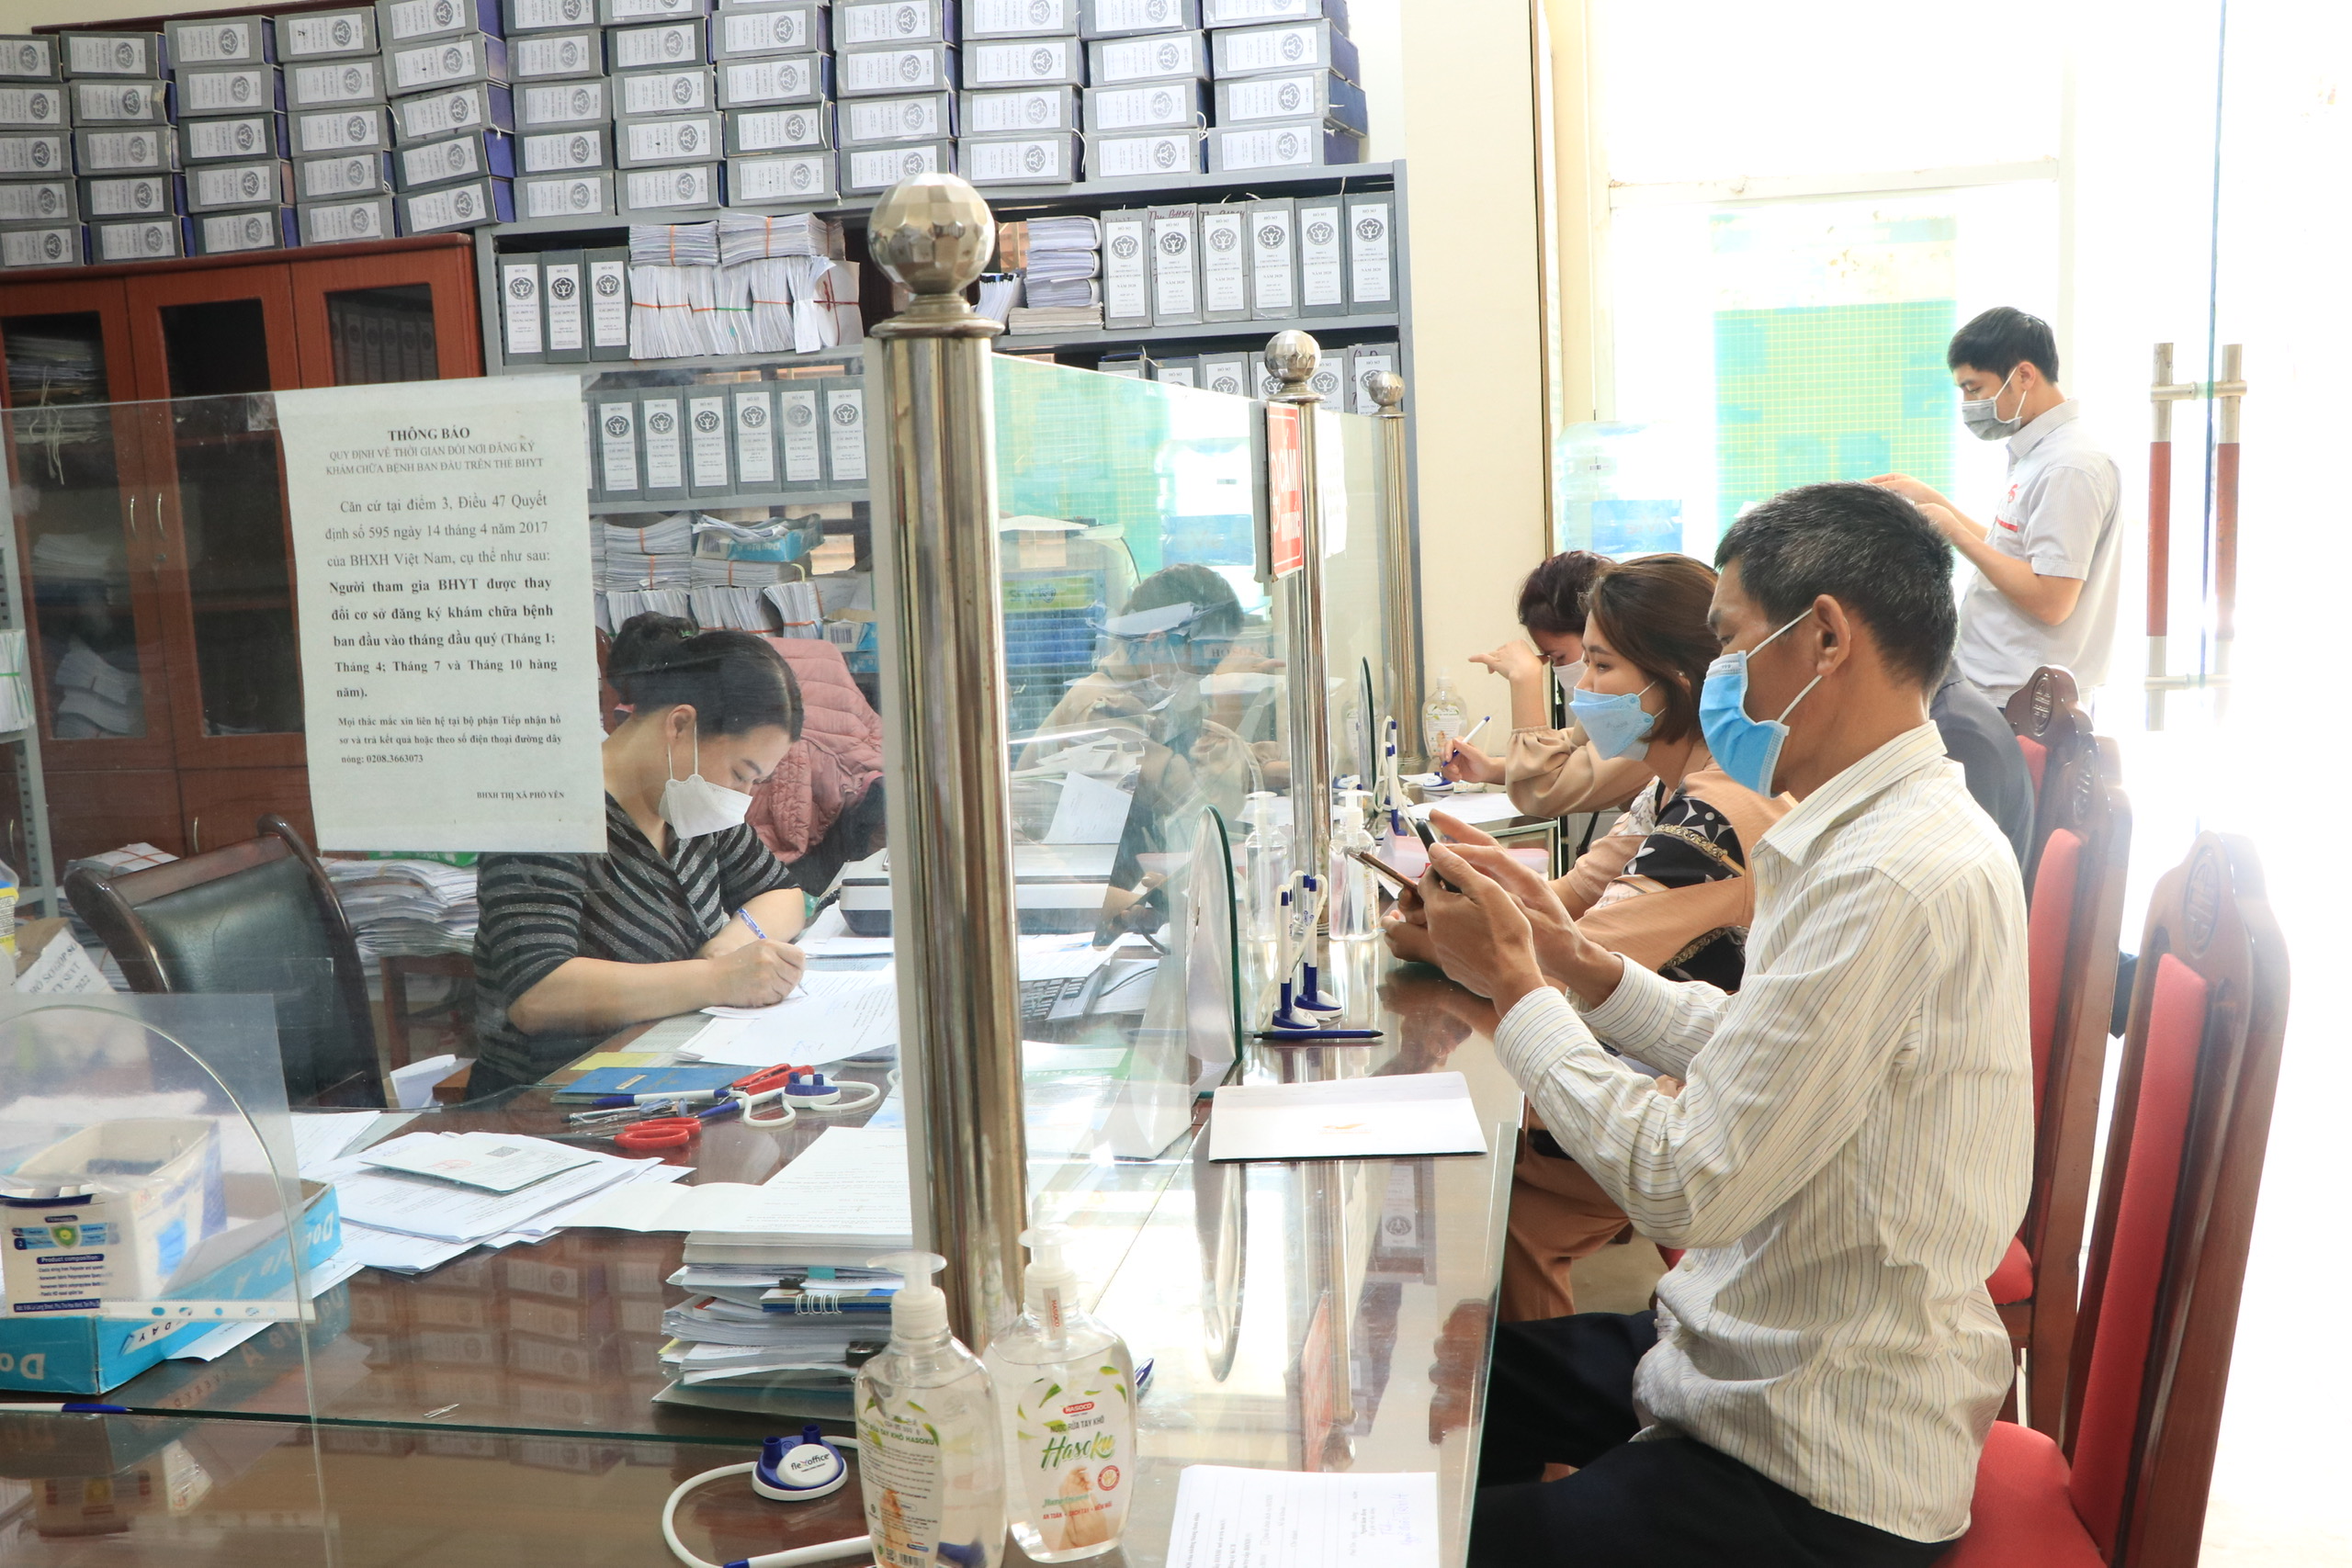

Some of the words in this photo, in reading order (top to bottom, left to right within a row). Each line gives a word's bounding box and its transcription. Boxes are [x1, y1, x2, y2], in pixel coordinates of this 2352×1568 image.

[386, 426, 438, 442] THÔNG
[441, 427, 471, 440] BÁO
[339, 501, 362, 513] Căn
[366, 500, 382, 513] cứ
[386, 499, 401, 513] tại
[406, 494, 437, 511] điểm
[441, 496, 453, 511] 3,
[458, 491, 487, 509] Điều
[492, 494, 506, 507] 47
[511, 490, 548, 510] Quyết
[324, 527, 349, 542] định
[352, 524, 366, 539] số
[369, 525, 390, 539] 595
[393, 525, 420, 541] ngày
[426, 525, 441, 536] 14
[445, 524, 476, 539] tháng
[479, 523, 488, 535] 4
[492, 523, 515, 535] năm
[518, 521, 549, 534] 2017
[326, 555, 346, 568] của
[350, 553, 390, 567] BHXH
[394, 552, 420, 567] Việt
[424, 552, 457, 565] Nam,
[459, 554, 474, 566] cụ
[478, 547, 497, 563] thể
[500, 549, 523, 562] như
[526, 551, 550, 561] sau:
[329, 581, 366, 596] Người
[371, 581, 404, 592] tham
[410, 580, 431, 594] gia
[437, 578, 479, 591] BHYT
[486, 578, 517, 592] được
[523, 577, 552, 592] thay
[331, 605, 350, 621] đổi
[354, 611, 368, 621] cơ
[372, 611, 387, 620] sở
[390, 607, 422, 622] đăng
[426, 606, 442, 622] ký
[447, 605, 483, 618] khám
[488, 605, 518, 617] chữa
[523, 604, 554, 620] bệnh
[333, 635, 356, 647] ban
[357, 631, 381, 647] đầu
[383, 634, 406, 646] vào
[408, 634, 445, 649] tháng
[447, 629, 471, 645] đầu
[474, 632, 498, 648] quý
[500, 633, 542, 646] (Tháng
[544, 632, 556, 644] 1;
[334, 661, 370, 674] Tháng
[375, 661, 387, 672] 4;
[391, 660, 429, 674] Tháng
[434, 660, 441, 671] 7
[447, 660, 461, 671] và
[469, 660, 504, 672] Tháng
[510, 659, 523, 671] 10
[528, 659, 559, 671] hàng
[335, 687, 368, 699] năm).
[338, 716, 356, 728] Mọi
[379, 715, 398, 726] mắc
[400, 716, 413, 726] xin
[415, 716, 432, 726] liên
[434, 716, 446, 728] hệ
[447, 716, 460, 728] tại
[462, 716, 474, 728] bộ
[477, 716, 499, 728] phận
[503, 715, 522, 728] Tiếp
[524, 715, 547, 727] nhận
[549, 713, 561, 725] hồ
[340, 756, 365, 765] nóng:
[365, 754, 424, 763] 0208.3663073
[476, 791, 499, 799] BHXH
[499, 792, 514, 801] THỊ
[548, 789, 565, 799] YÊN
[1080, 1420, 1092, 1428] TAY
[905, 1436, 934, 1445] HASOKU
